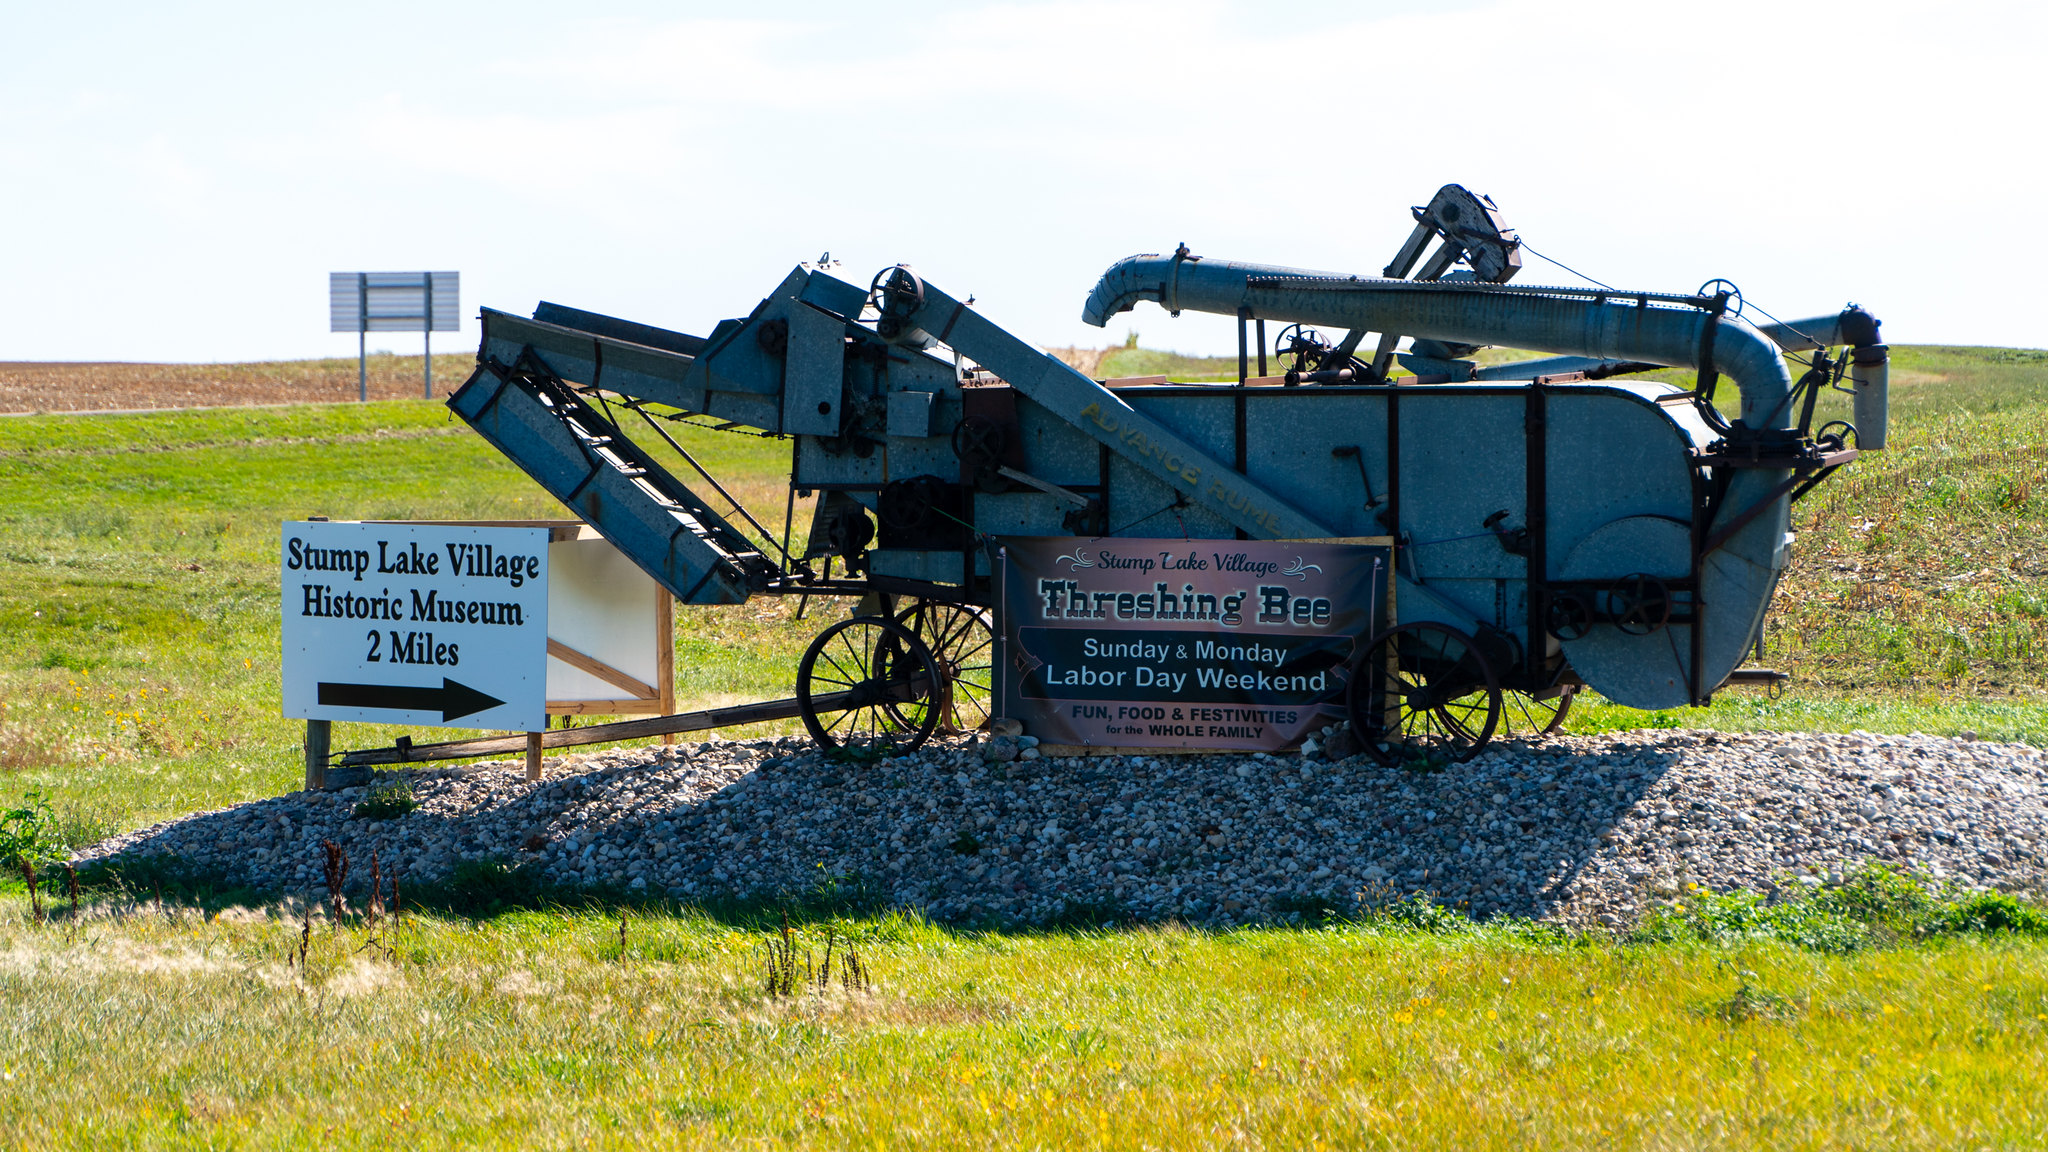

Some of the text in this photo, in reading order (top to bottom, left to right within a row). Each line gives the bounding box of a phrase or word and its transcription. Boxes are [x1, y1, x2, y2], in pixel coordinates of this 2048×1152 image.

[1081, 403, 1201, 486] ADVANCE
[287, 537, 539, 587] Stump Lake Village
[1097, 551, 1279, 578] Stump Lake Village
[302, 584, 524, 626] Historic Museum
[1039, 578, 1332, 627] Threshing Bee
[366, 629, 459, 666] 2 Miles
[1083, 637, 1287, 668] Sunday & Monday
[1046, 664, 1326, 693] Labor Day Weekend
[1072, 704, 1298, 724] FUN, FOOD & FESTIVITIES
[1105, 724, 1264, 739] for the WHOLE FAMILY
